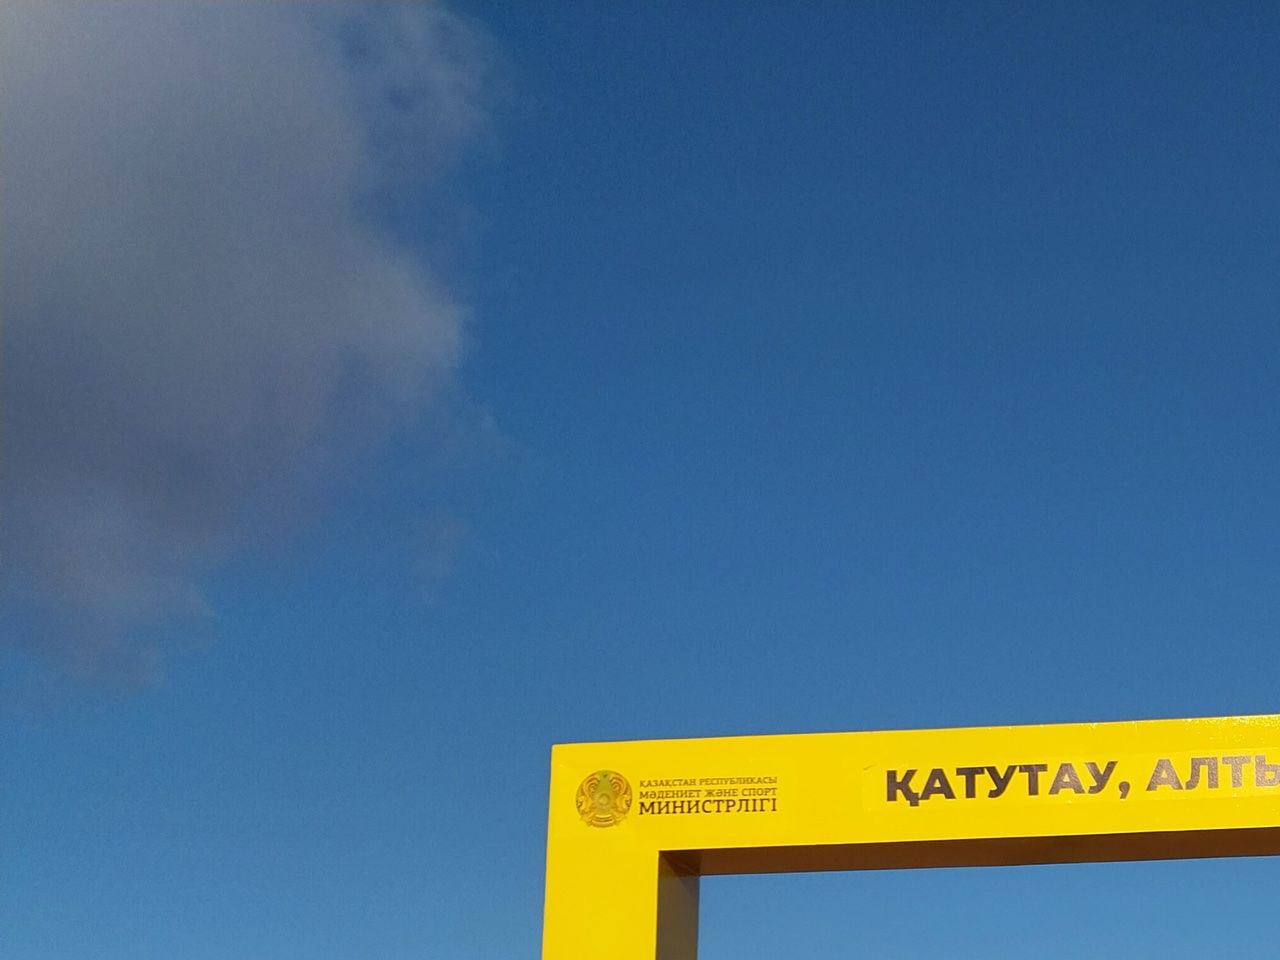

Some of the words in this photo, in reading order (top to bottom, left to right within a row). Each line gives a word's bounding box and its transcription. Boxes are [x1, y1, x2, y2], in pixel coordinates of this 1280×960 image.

[698, 776, 778, 786] РЕСПУБЛИКАСЫ
[885, 760, 1131, 808] ҚАТУТАУ,
[639, 789, 702, 800] МӘДЕНИЕТ
[704, 788, 739, 798] ЖӘНЕ
[741, 787, 778, 797] СПОРТ
[638, 798, 777, 816] МИНИСТРЛІГІ
